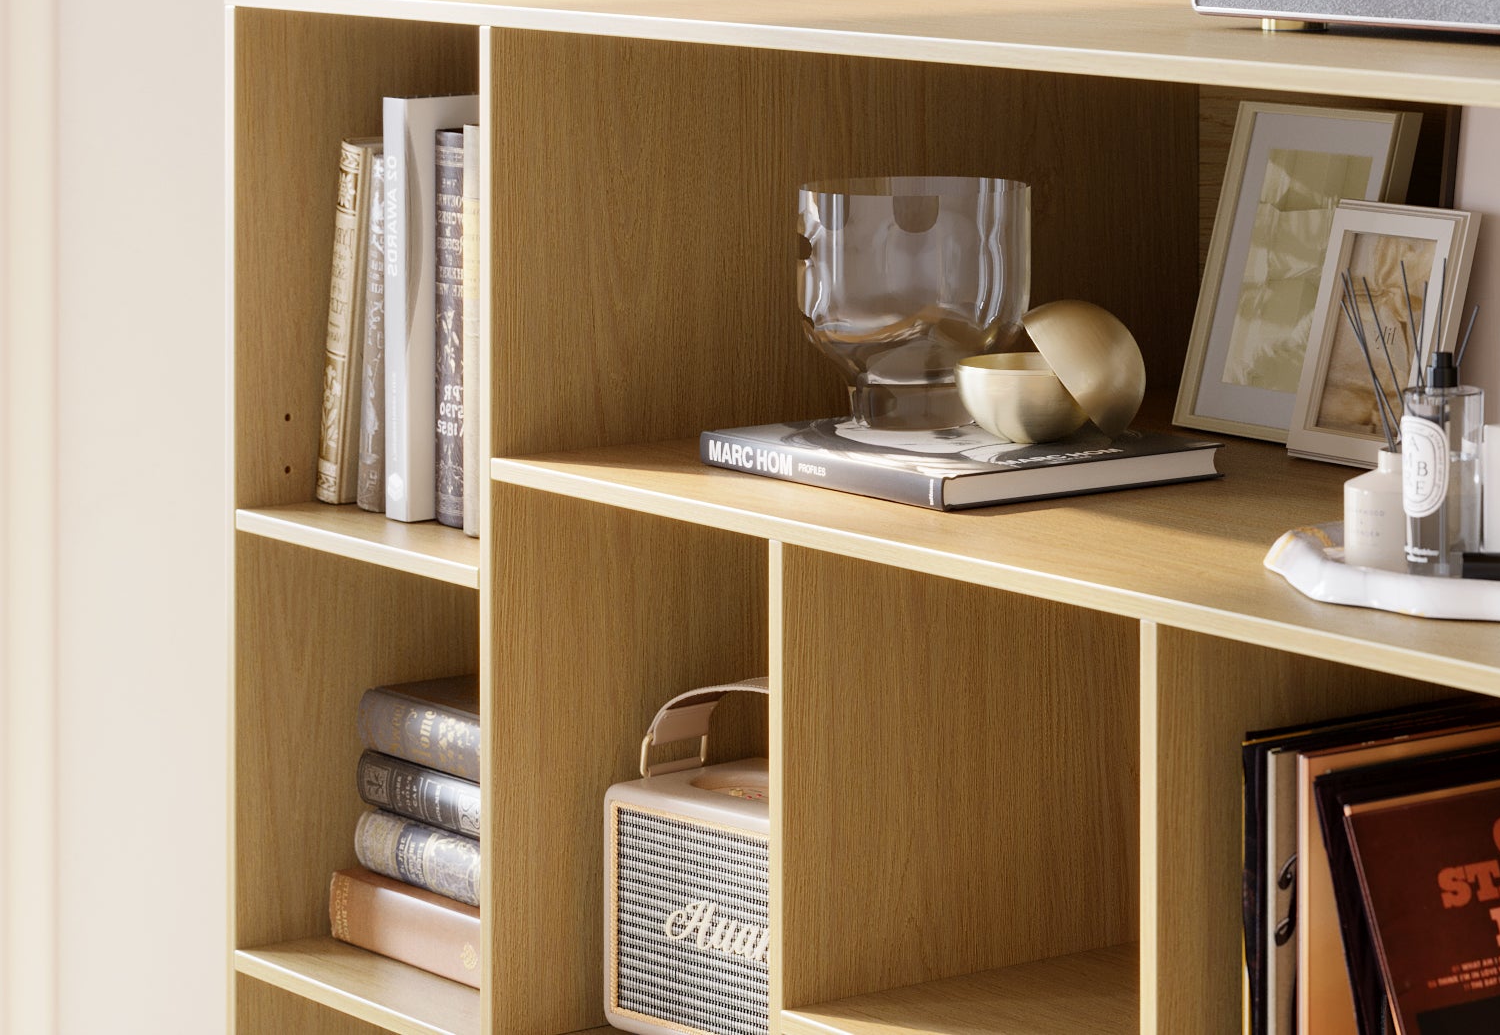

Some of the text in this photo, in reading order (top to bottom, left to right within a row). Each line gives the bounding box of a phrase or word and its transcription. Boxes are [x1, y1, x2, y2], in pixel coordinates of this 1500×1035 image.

[709, 440, 826, 477] MARC HOM PROFILES
